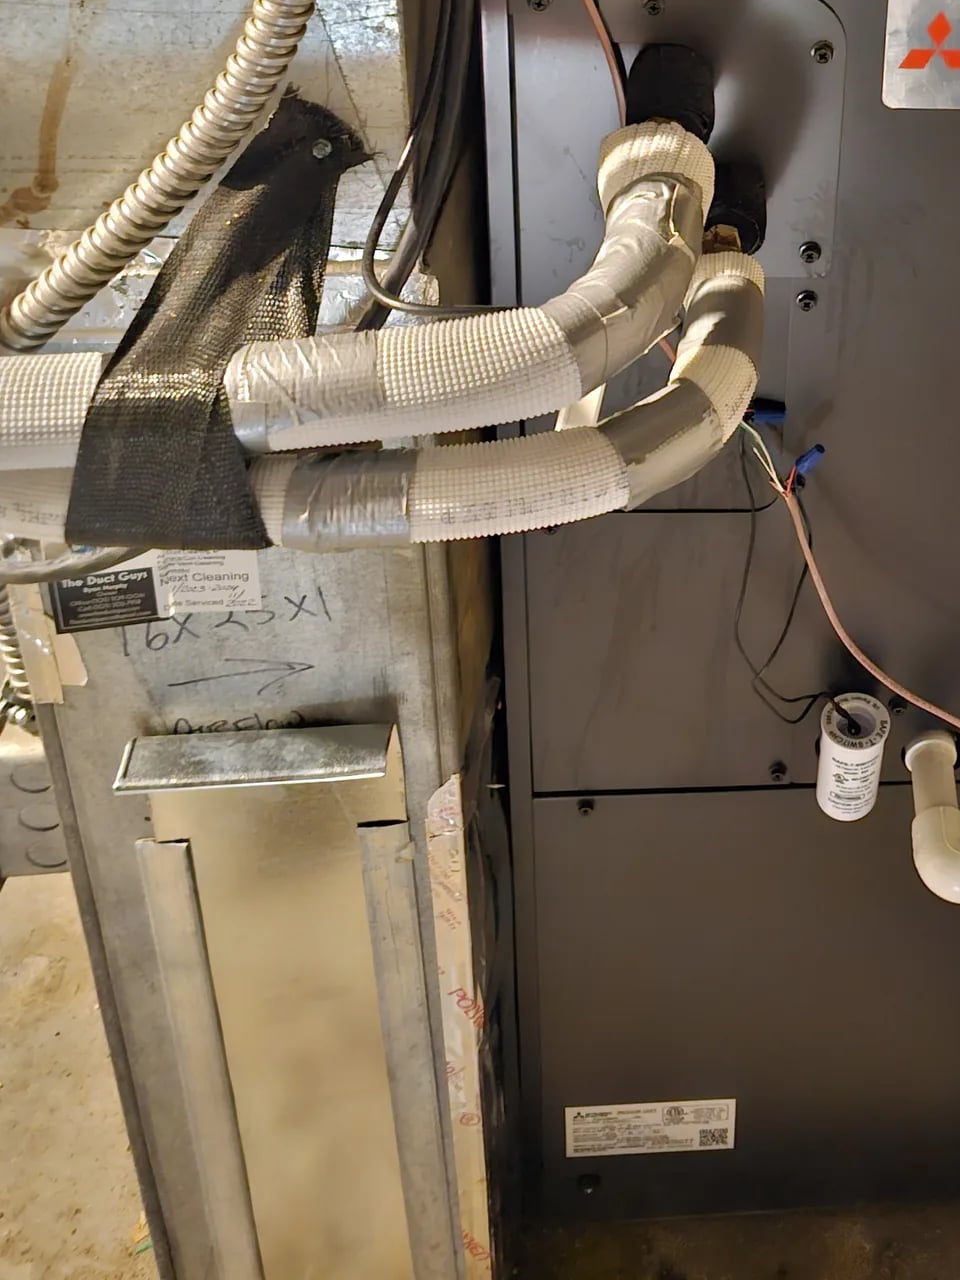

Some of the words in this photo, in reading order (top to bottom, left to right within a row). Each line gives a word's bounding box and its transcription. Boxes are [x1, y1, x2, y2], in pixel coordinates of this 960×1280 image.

[61, 578, 84, 589] The
[87, 574, 115, 586] Duct
[118, 571, 148, 582] Guys
[192, 571, 249, 583] Cleaning
[185, 599, 224, 607] Serviced
